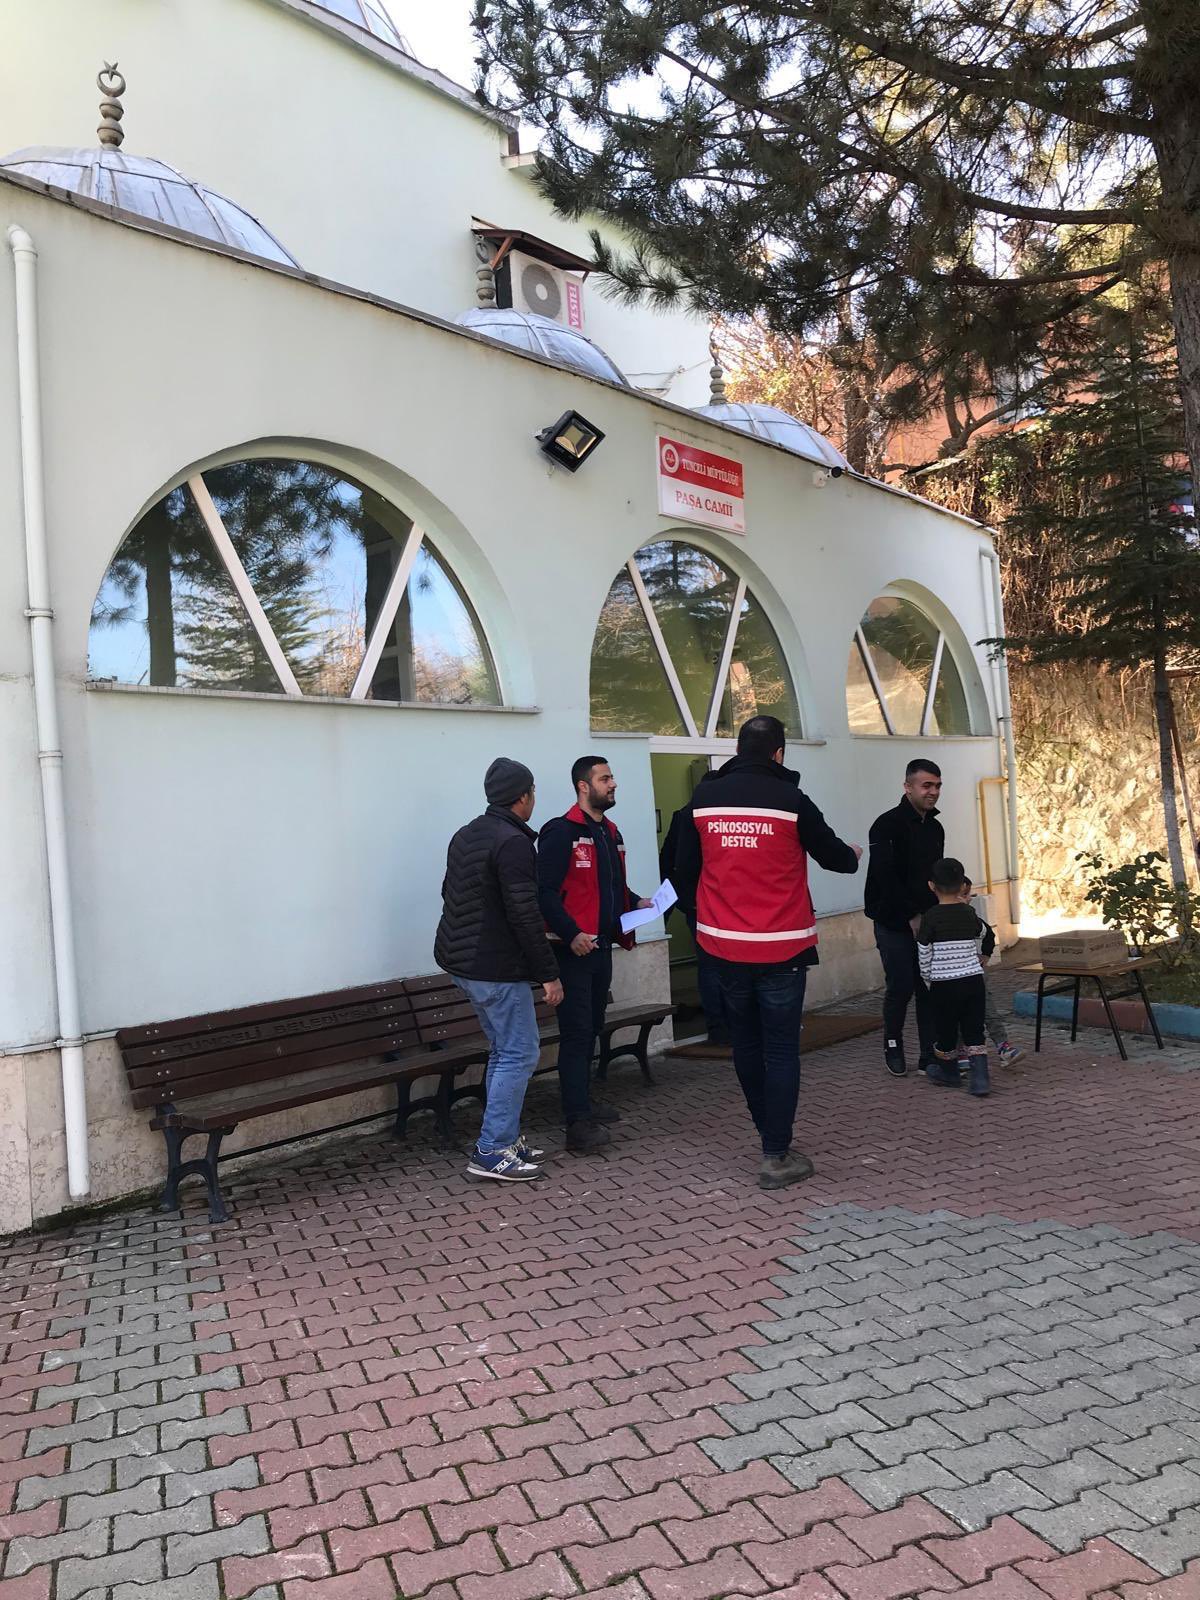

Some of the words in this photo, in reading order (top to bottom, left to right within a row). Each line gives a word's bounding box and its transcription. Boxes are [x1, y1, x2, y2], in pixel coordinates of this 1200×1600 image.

[569, 285, 579, 327] VESTEL
[682, 458, 707, 476] TUNCELİ
[675, 490, 703, 509] PAŞA
[704, 498, 733, 517] CAMİİ
[707, 819, 775, 835] PSİKOSOSYAL
[721, 835, 758, 848] DESTEK
[173, 1026, 262, 1053] TUNCELİ
[496, 1160, 509, 1172] FILA
